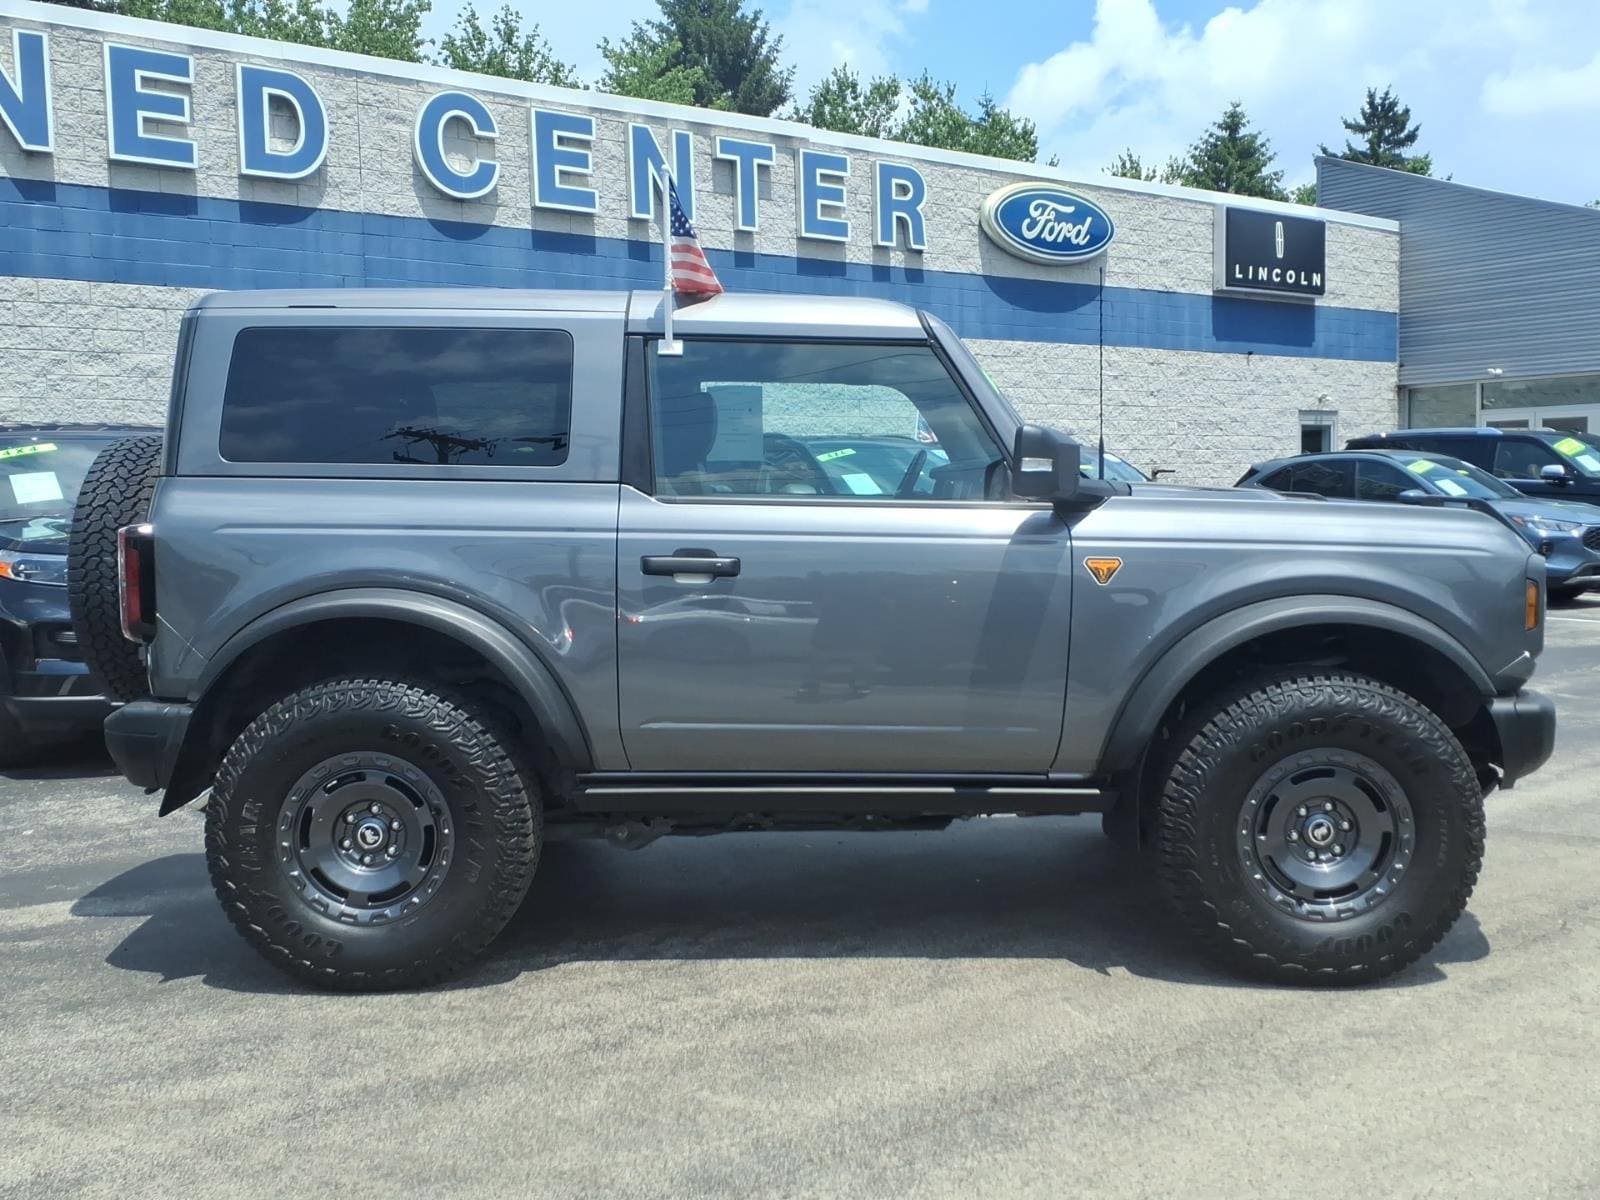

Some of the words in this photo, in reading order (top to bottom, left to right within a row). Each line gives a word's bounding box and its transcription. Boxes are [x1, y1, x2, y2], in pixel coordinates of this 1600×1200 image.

[413, 89, 929, 251] CENTER
[1021, 198, 1093, 247] Ford
[1235, 263, 1322, 288] LINCOLN
